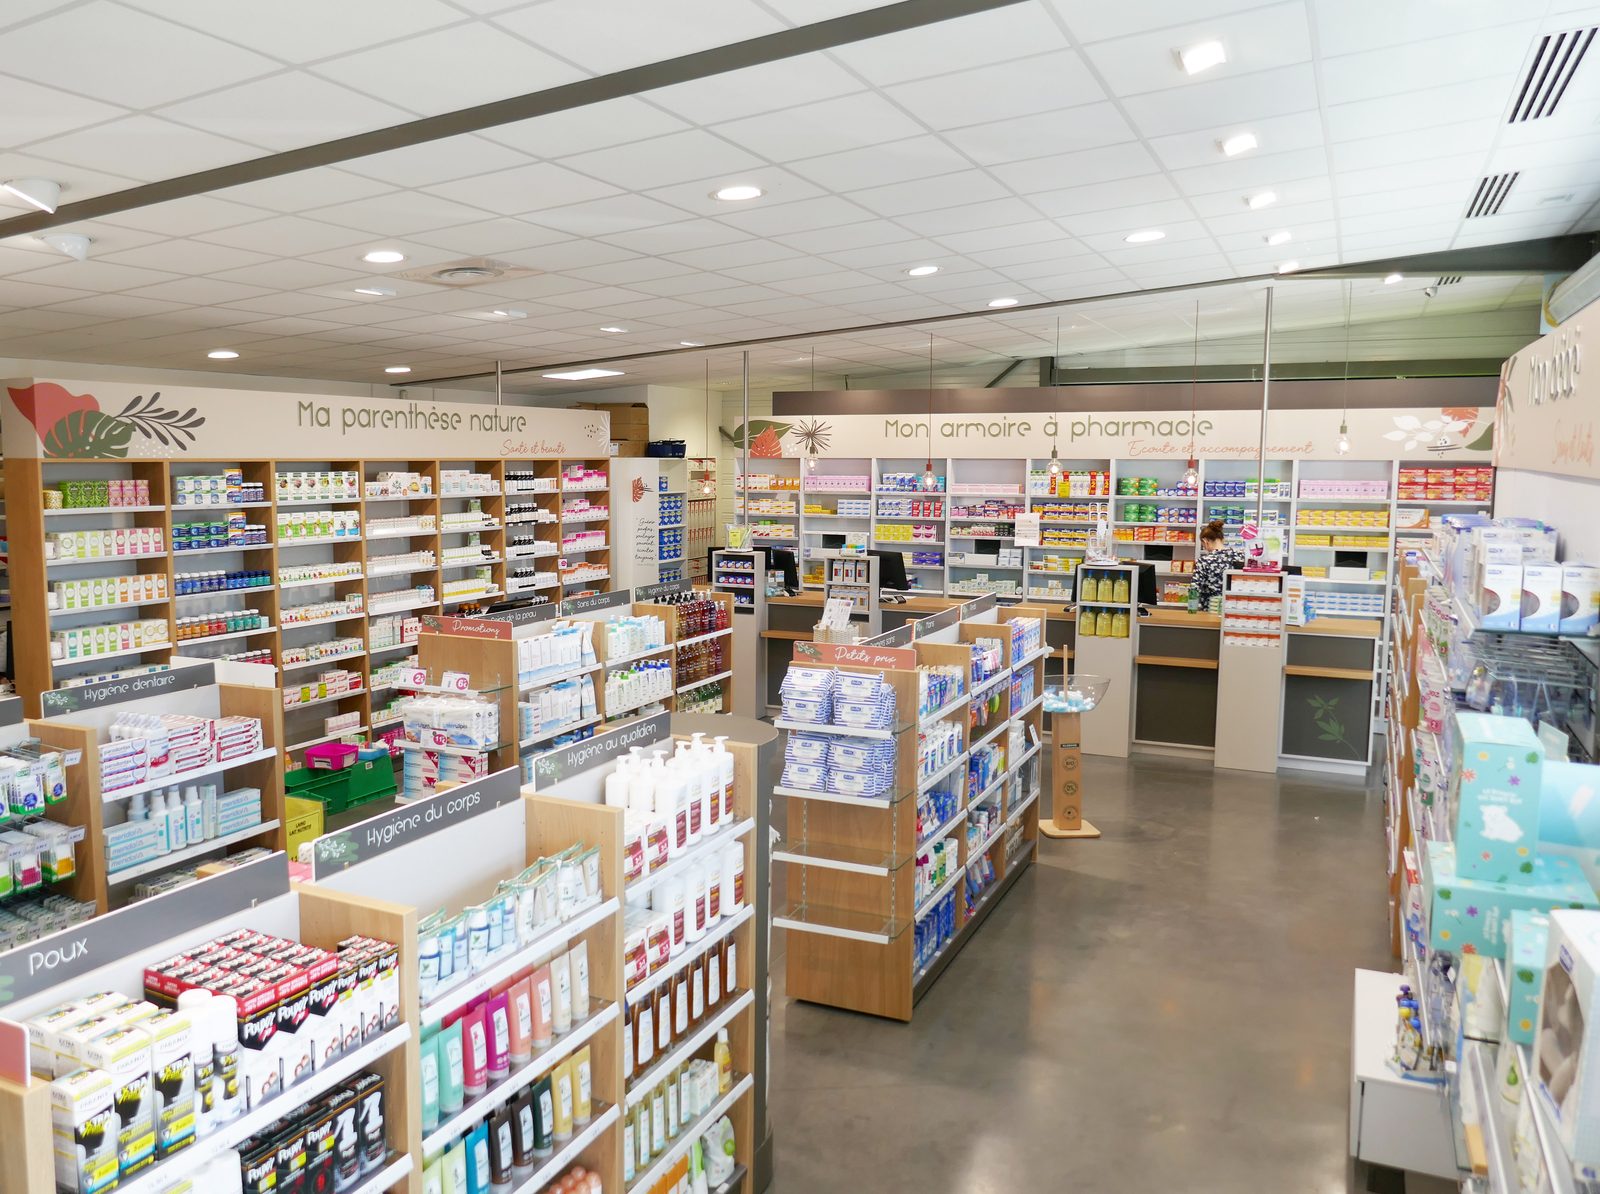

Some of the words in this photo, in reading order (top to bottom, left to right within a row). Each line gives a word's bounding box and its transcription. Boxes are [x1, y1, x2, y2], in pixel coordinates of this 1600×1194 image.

[298, 400, 331, 428] Ma
[342, 403, 462, 435] parenthèse
[470, 408, 527, 432] nature
[885, 419, 929, 438] Mon
[940, 416, 1032, 438] armoire
[1043, 416, 1058, 437] à
[1071, 413, 1213, 443] pharmacie
[500, 439, 528, 456] Santé
[530, 442, 539, 454] et
[540, 440, 567, 454] beauté
[1181, 443, 1195, 455] et
[1200, 441, 1314, 459] accompagement
[590, 599, 597, 607] du
[597, 596, 611, 605] corps
[452, 619, 501, 635] Promotions
[515, 612, 521, 621] la
[522, 611, 537, 621] peau
[835, 647, 870, 663] Petits
[874, 652, 897, 666] prix
[84, 684, 129, 703] Hygiène
[132, 675, 176, 691] dentaire
[567, 744, 603, 768] Hygiène
[605, 738, 618, 751] au
[620, 723, 657, 748] quotidien
[367, 814, 421, 848] Hygiène
[425, 803, 443, 823] du
[447, 791, 481, 812] corps
[29, 938, 89, 977] Poux
